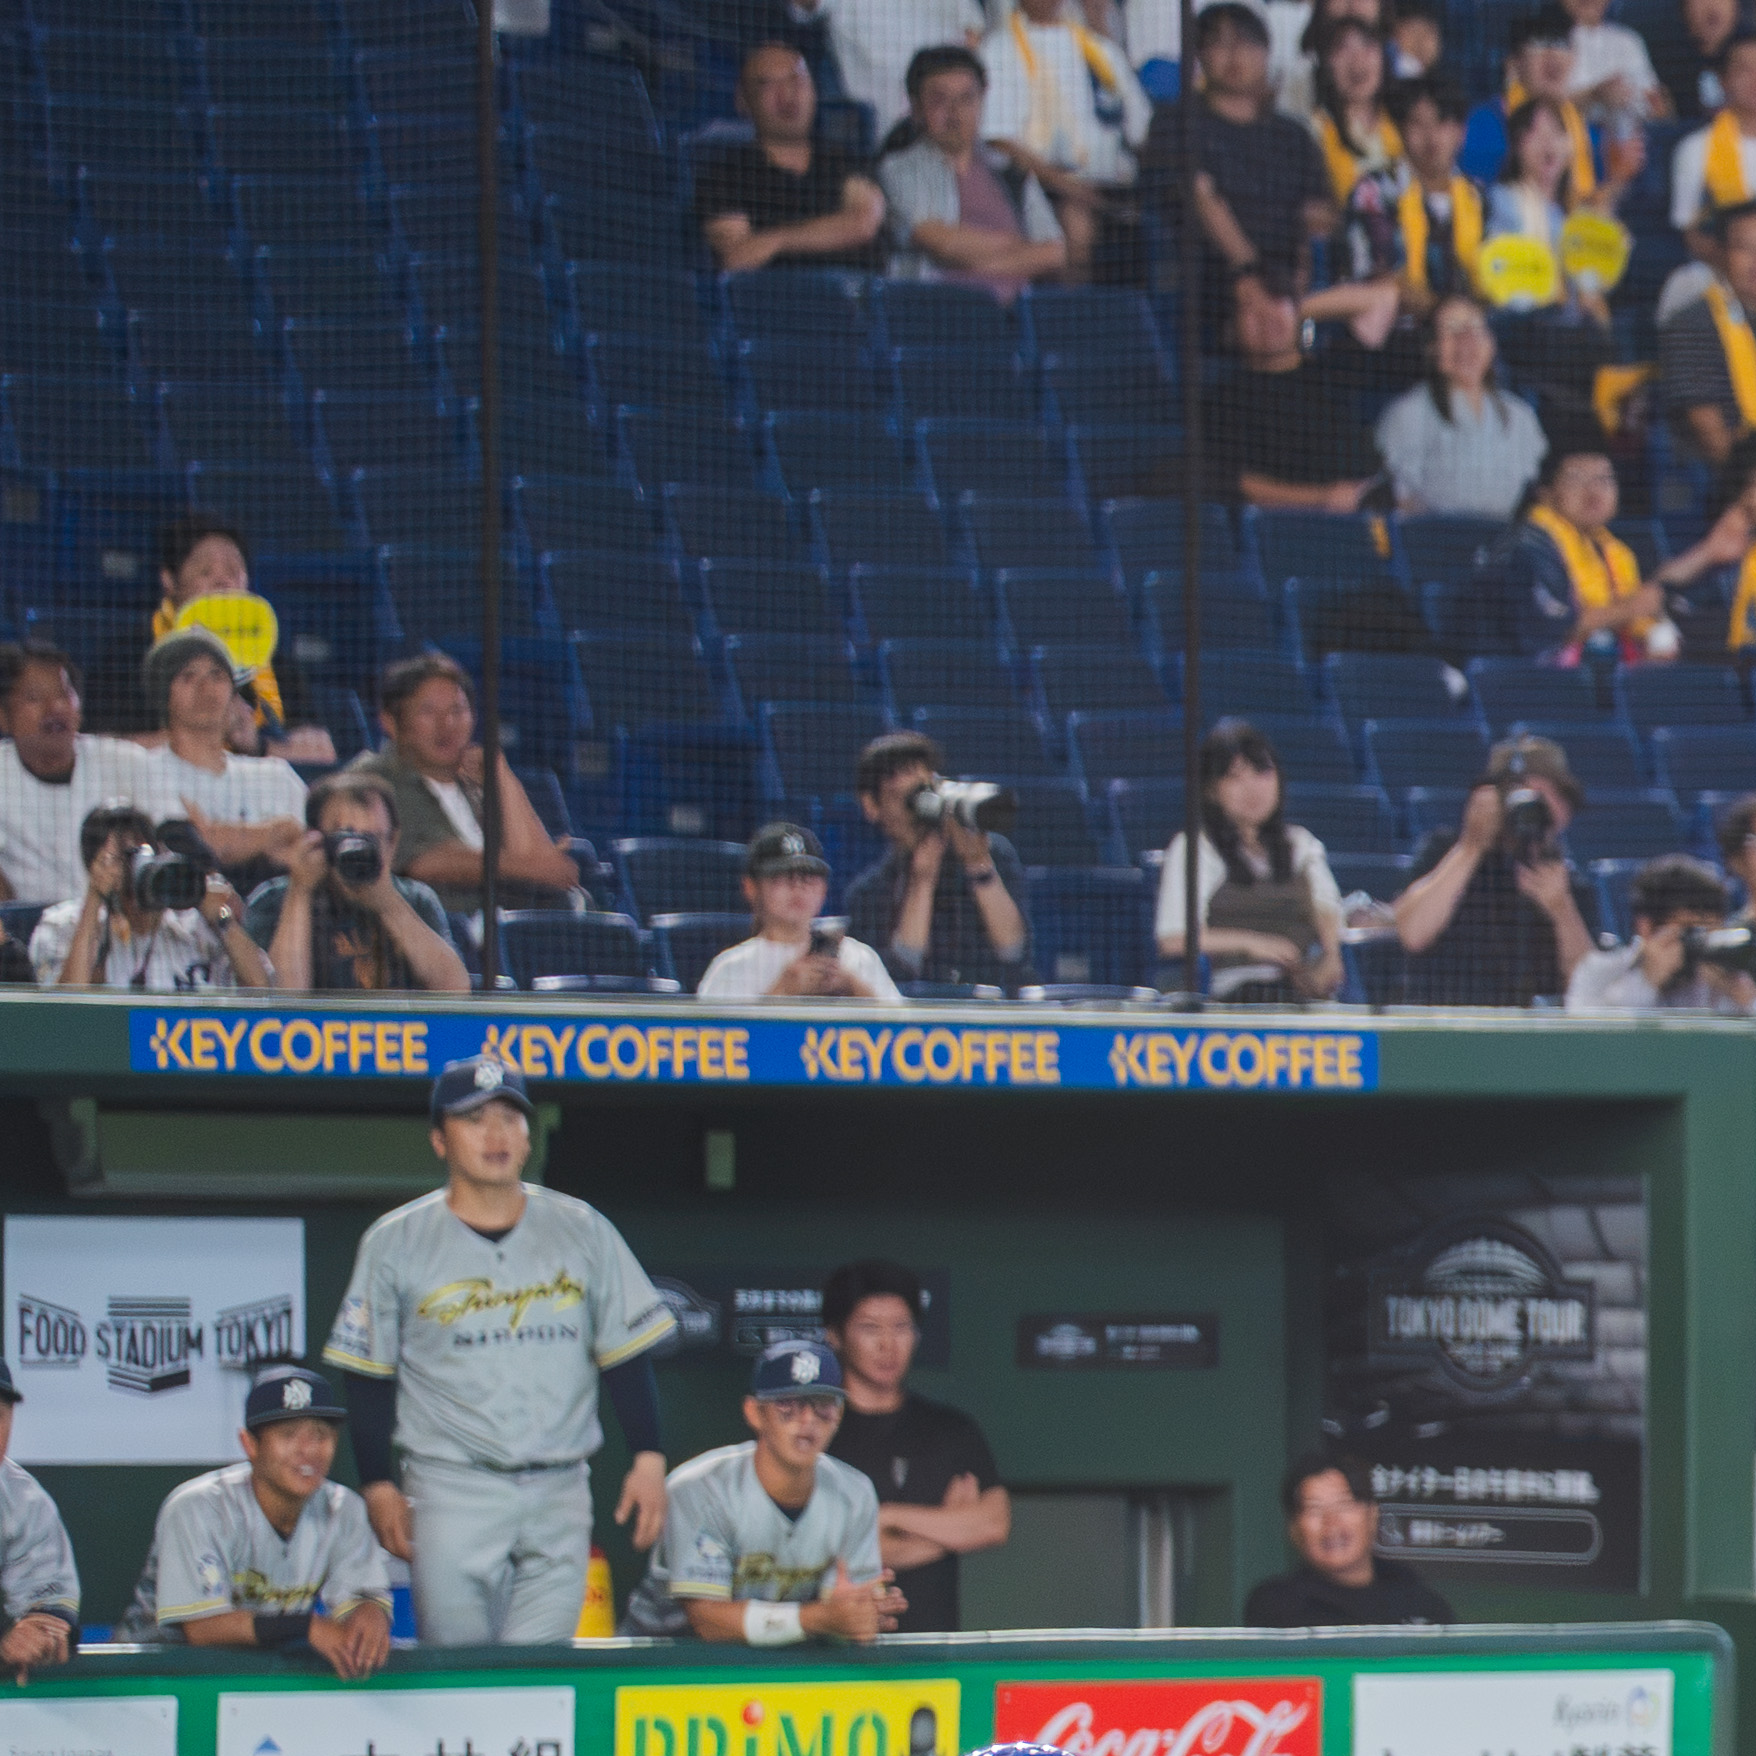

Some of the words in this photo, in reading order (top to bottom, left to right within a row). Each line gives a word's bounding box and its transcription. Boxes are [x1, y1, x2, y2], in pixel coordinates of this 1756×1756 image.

[18, 1301, 86, 1358] FOOD
[96, 1320, 204, 1369] STADIUM
[213, 1306, 293, 1362] TOKYO
